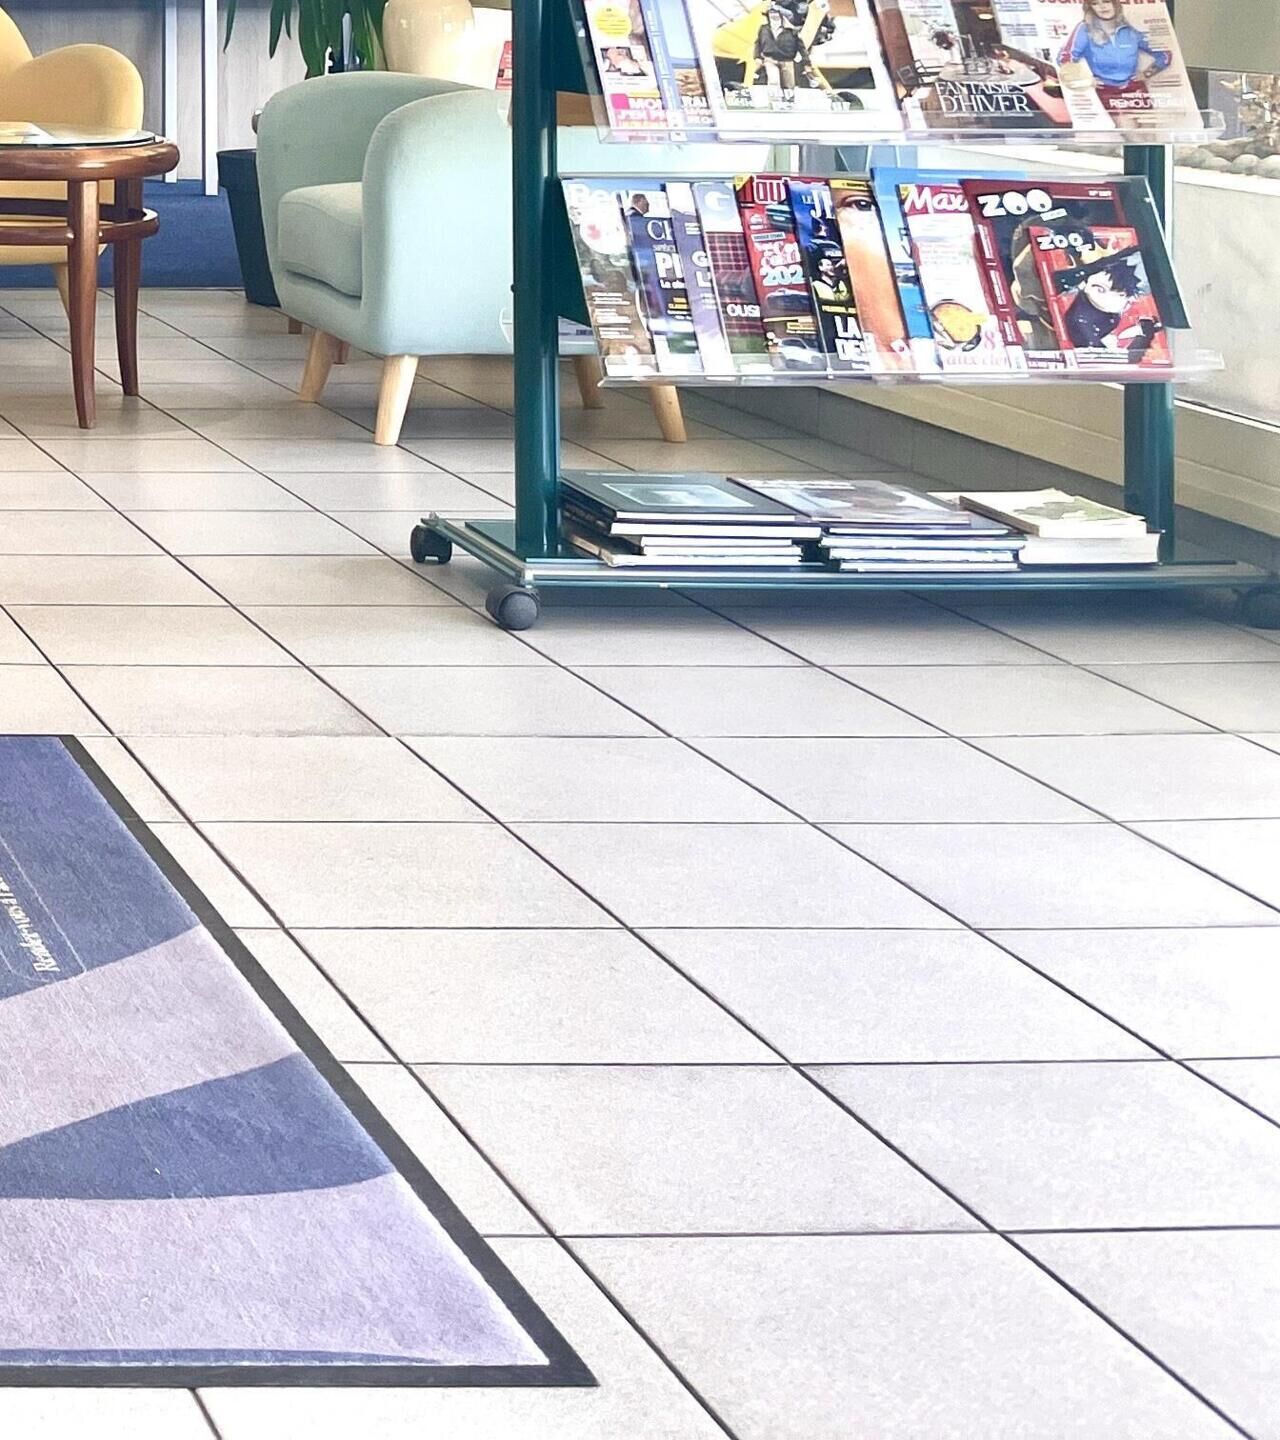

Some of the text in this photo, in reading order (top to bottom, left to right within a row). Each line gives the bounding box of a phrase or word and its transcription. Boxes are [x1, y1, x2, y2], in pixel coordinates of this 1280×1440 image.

[935, 81, 1026, 95] FANTAISIES
[939, 94, 1030, 113] D'HIVER
[977, 188, 1053, 217] ZOO
[8, 905, 61, 972] Rendez-vous
